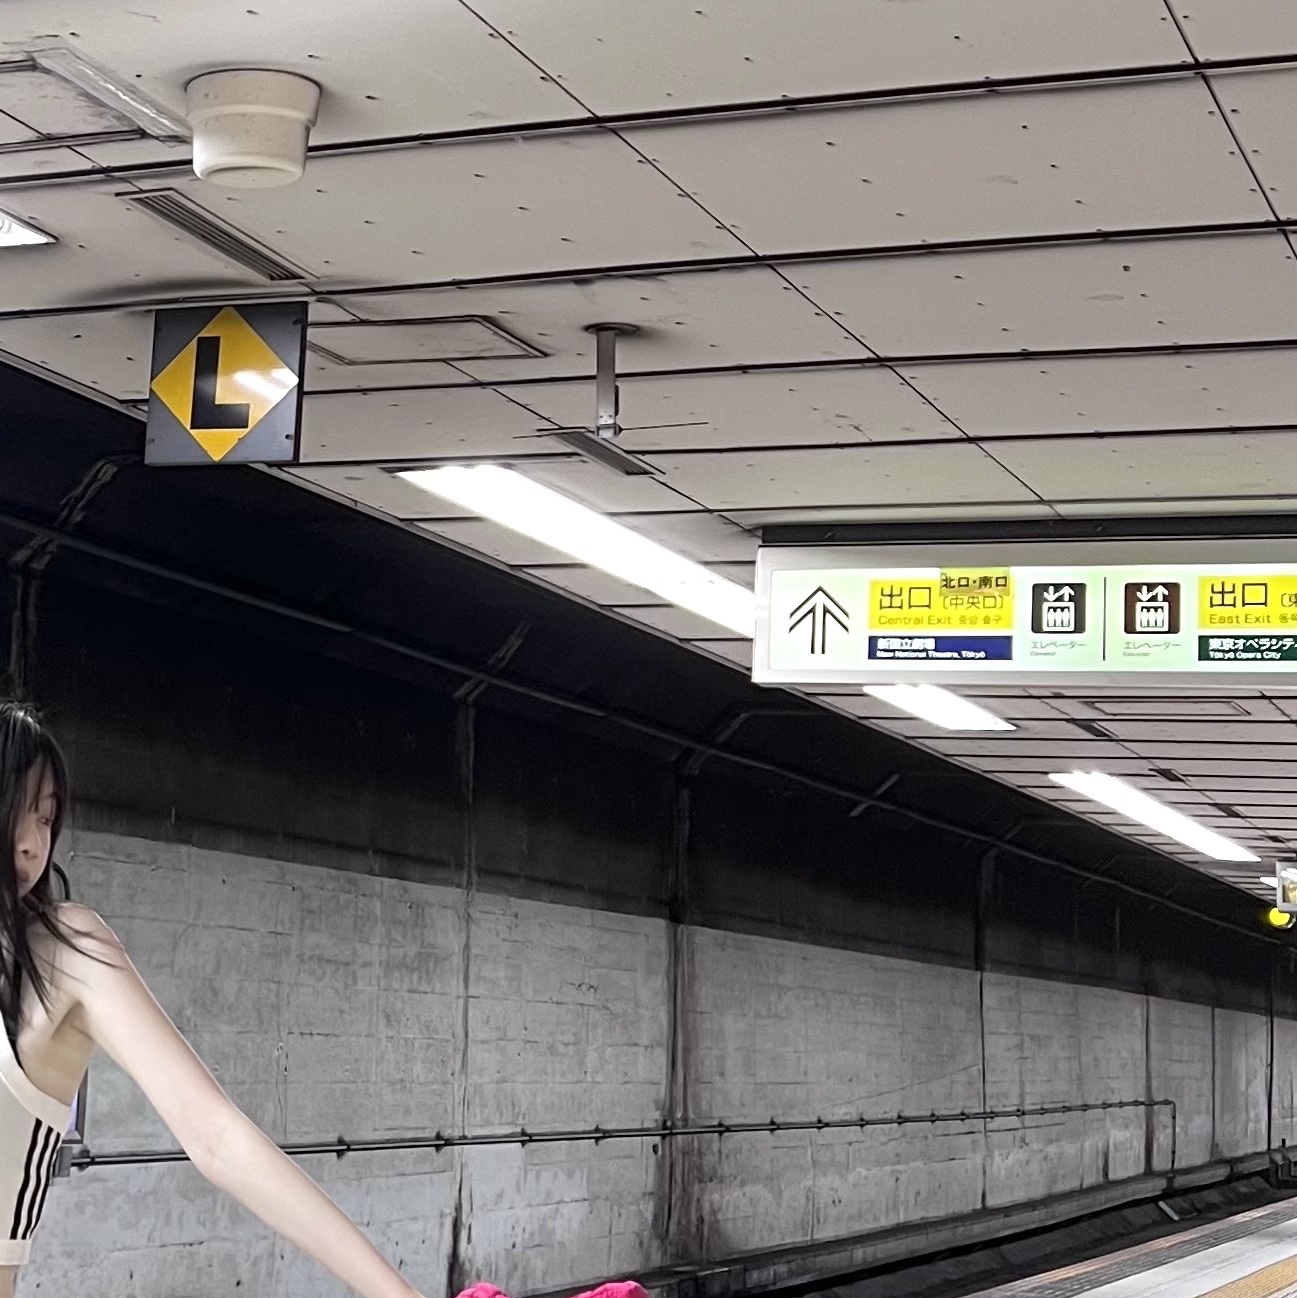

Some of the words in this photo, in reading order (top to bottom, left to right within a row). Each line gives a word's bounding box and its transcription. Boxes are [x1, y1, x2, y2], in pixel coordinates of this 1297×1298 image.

[190, 336, 251, 430] L
[879, 584, 932, 610] 出口
[1209, 581, 1268, 608] 出口
[878, 614, 924, 625] Central
[927, 614, 952, 625] Exit
[1209, 613, 1241, 624] East
[1244, 613, 1271, 624] Exit
[1208, 638, 1297, 650] 東京オペラシテ
[1263, 651, 1282, 660] City
